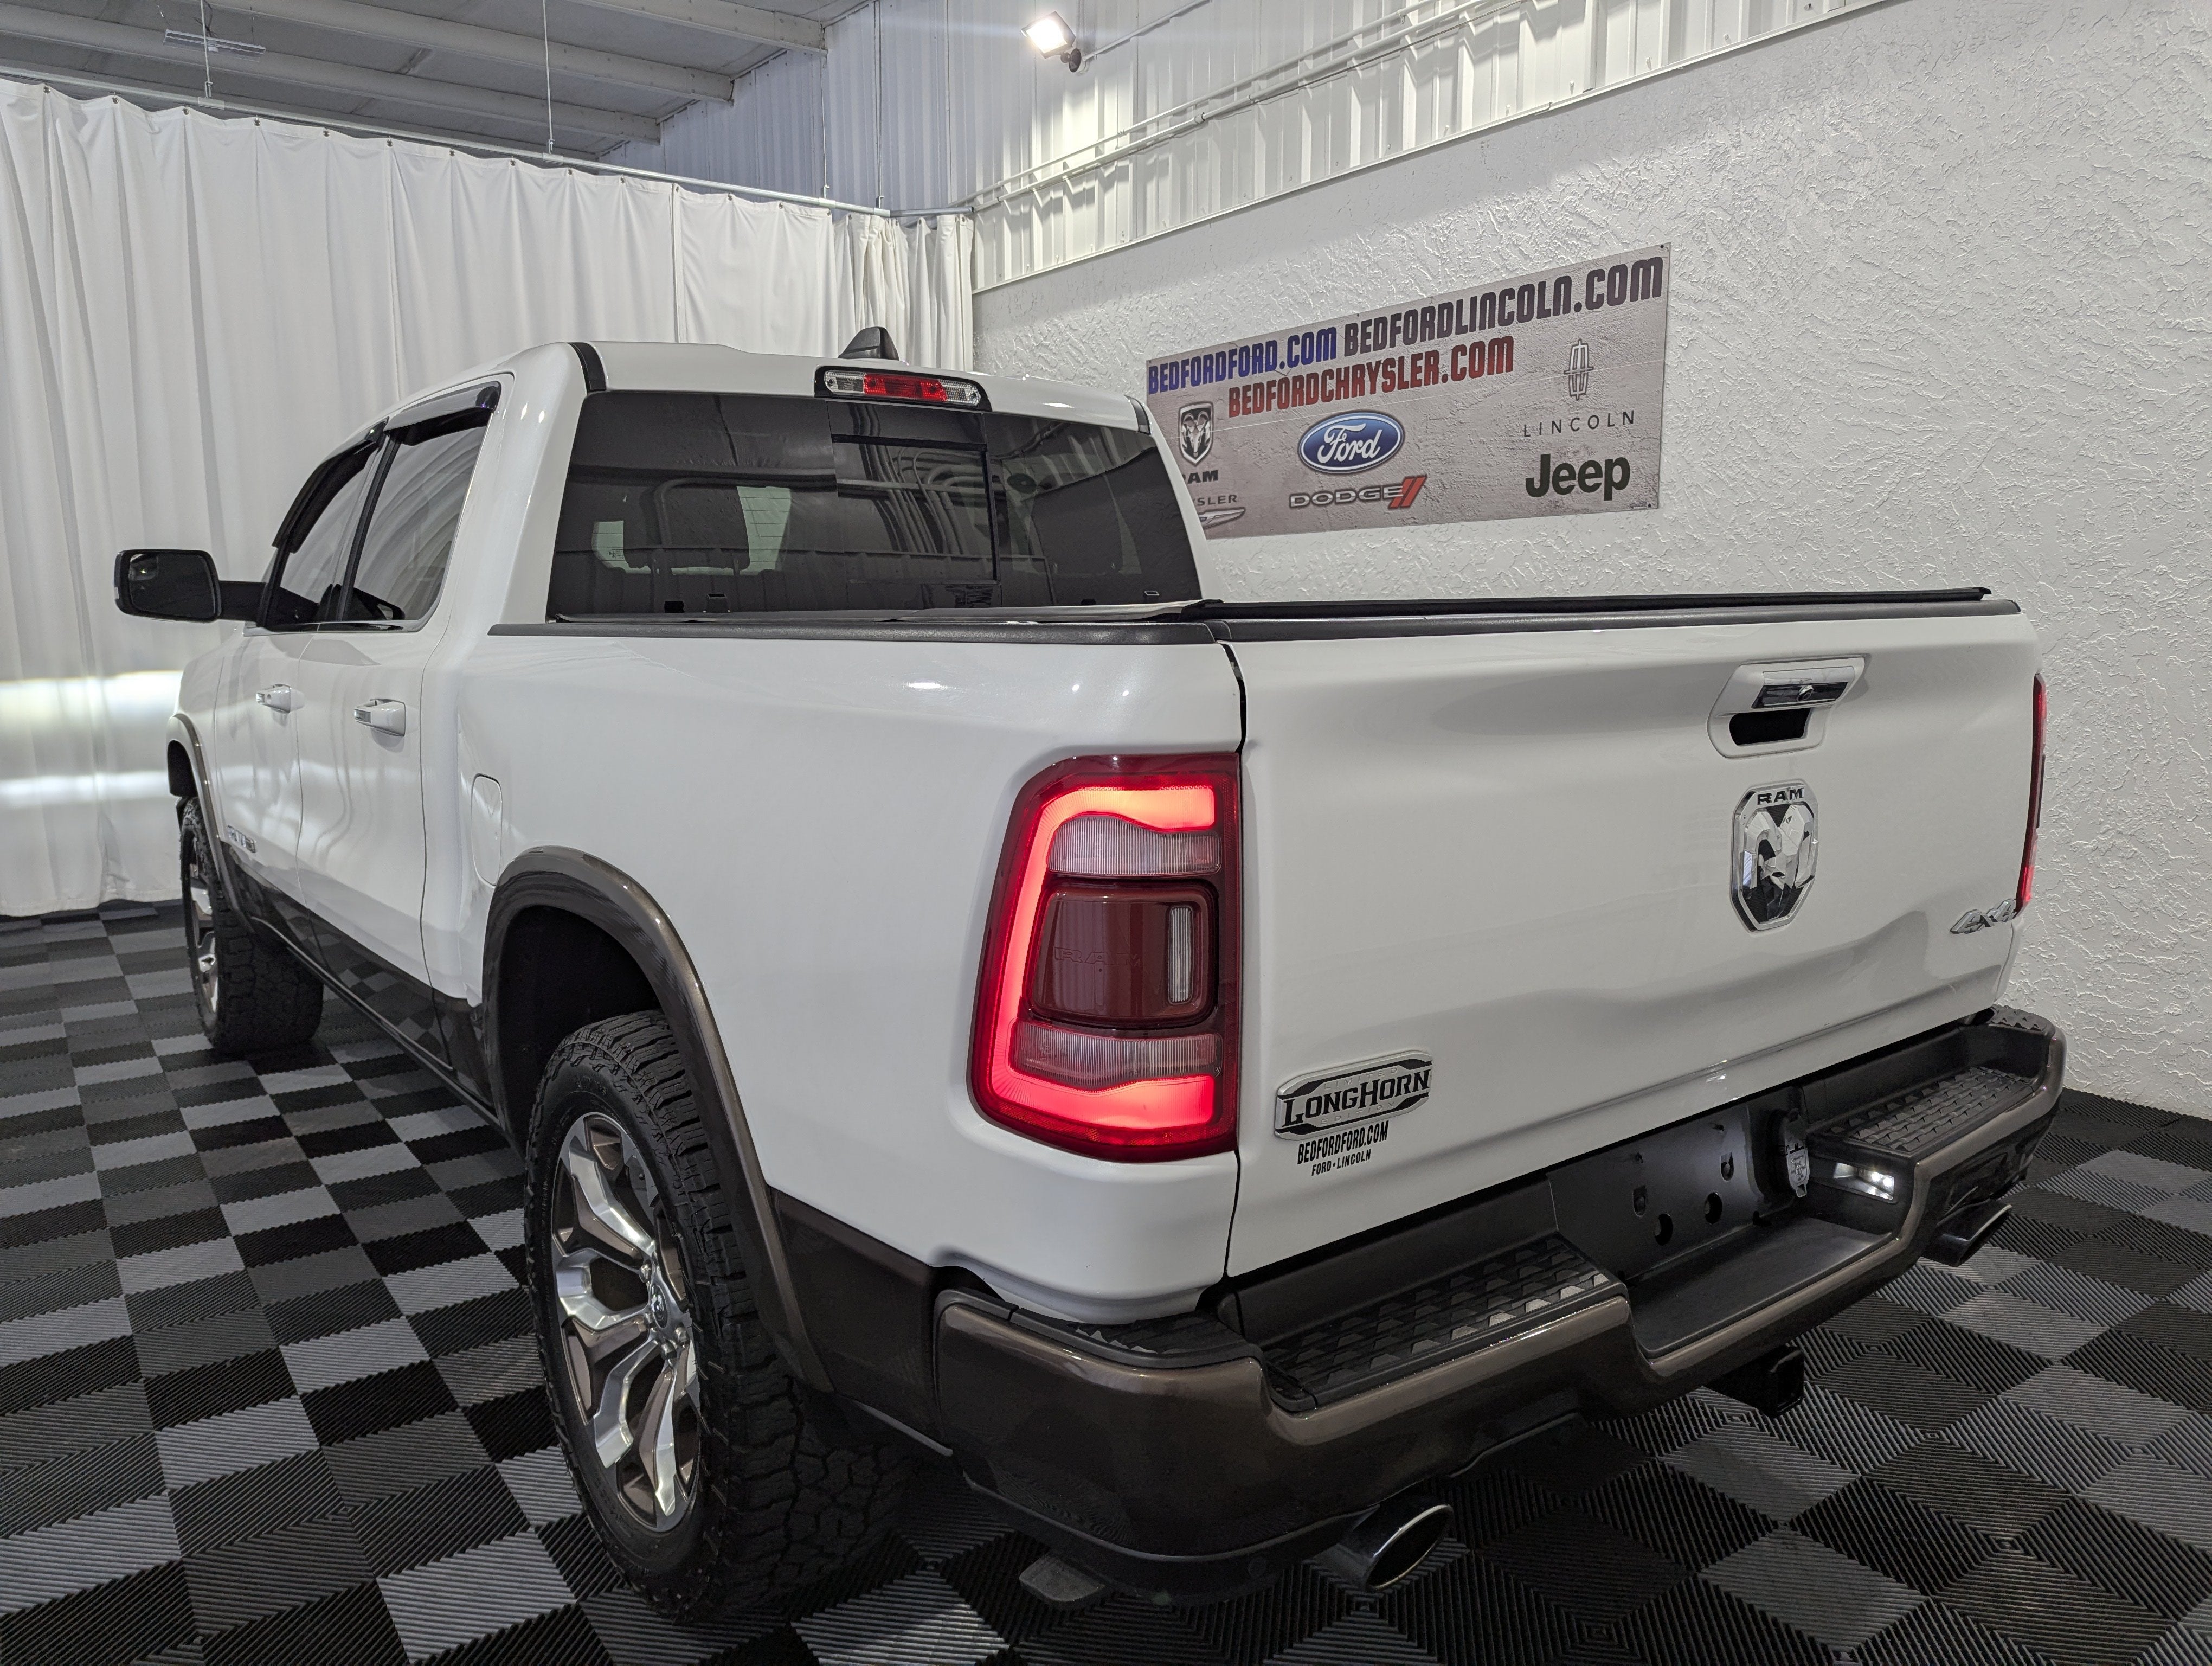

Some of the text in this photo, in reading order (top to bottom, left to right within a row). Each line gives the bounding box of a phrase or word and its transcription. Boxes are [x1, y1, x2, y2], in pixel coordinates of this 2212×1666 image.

[1148, 255, 1663, 395] BEDFORDFORD.COM BEDFORDLINCOLN.COM
[1228, 335, 1514, 418] BEDFORDCHRYSLER.COM
[1523, 409, 1634, 438] LINCOLN
[1317, 422, 1383, 464] Ford
[1525, 453, 1631, 501] Jeep
[1289, 483, 1404, 509] DODGE
[1757, 787, 1805, 805] RAM
[1053, 946, 1142, 967] RAM
[1323, 1066, 1398, 1090] LIMITED
[1281, 1068, 1432, 1128] LONGHORN
[1321, 1101, 1395, 1125] EDITION
[1297, 1120, 1390, 1165] BEDFORDFORD.COM
